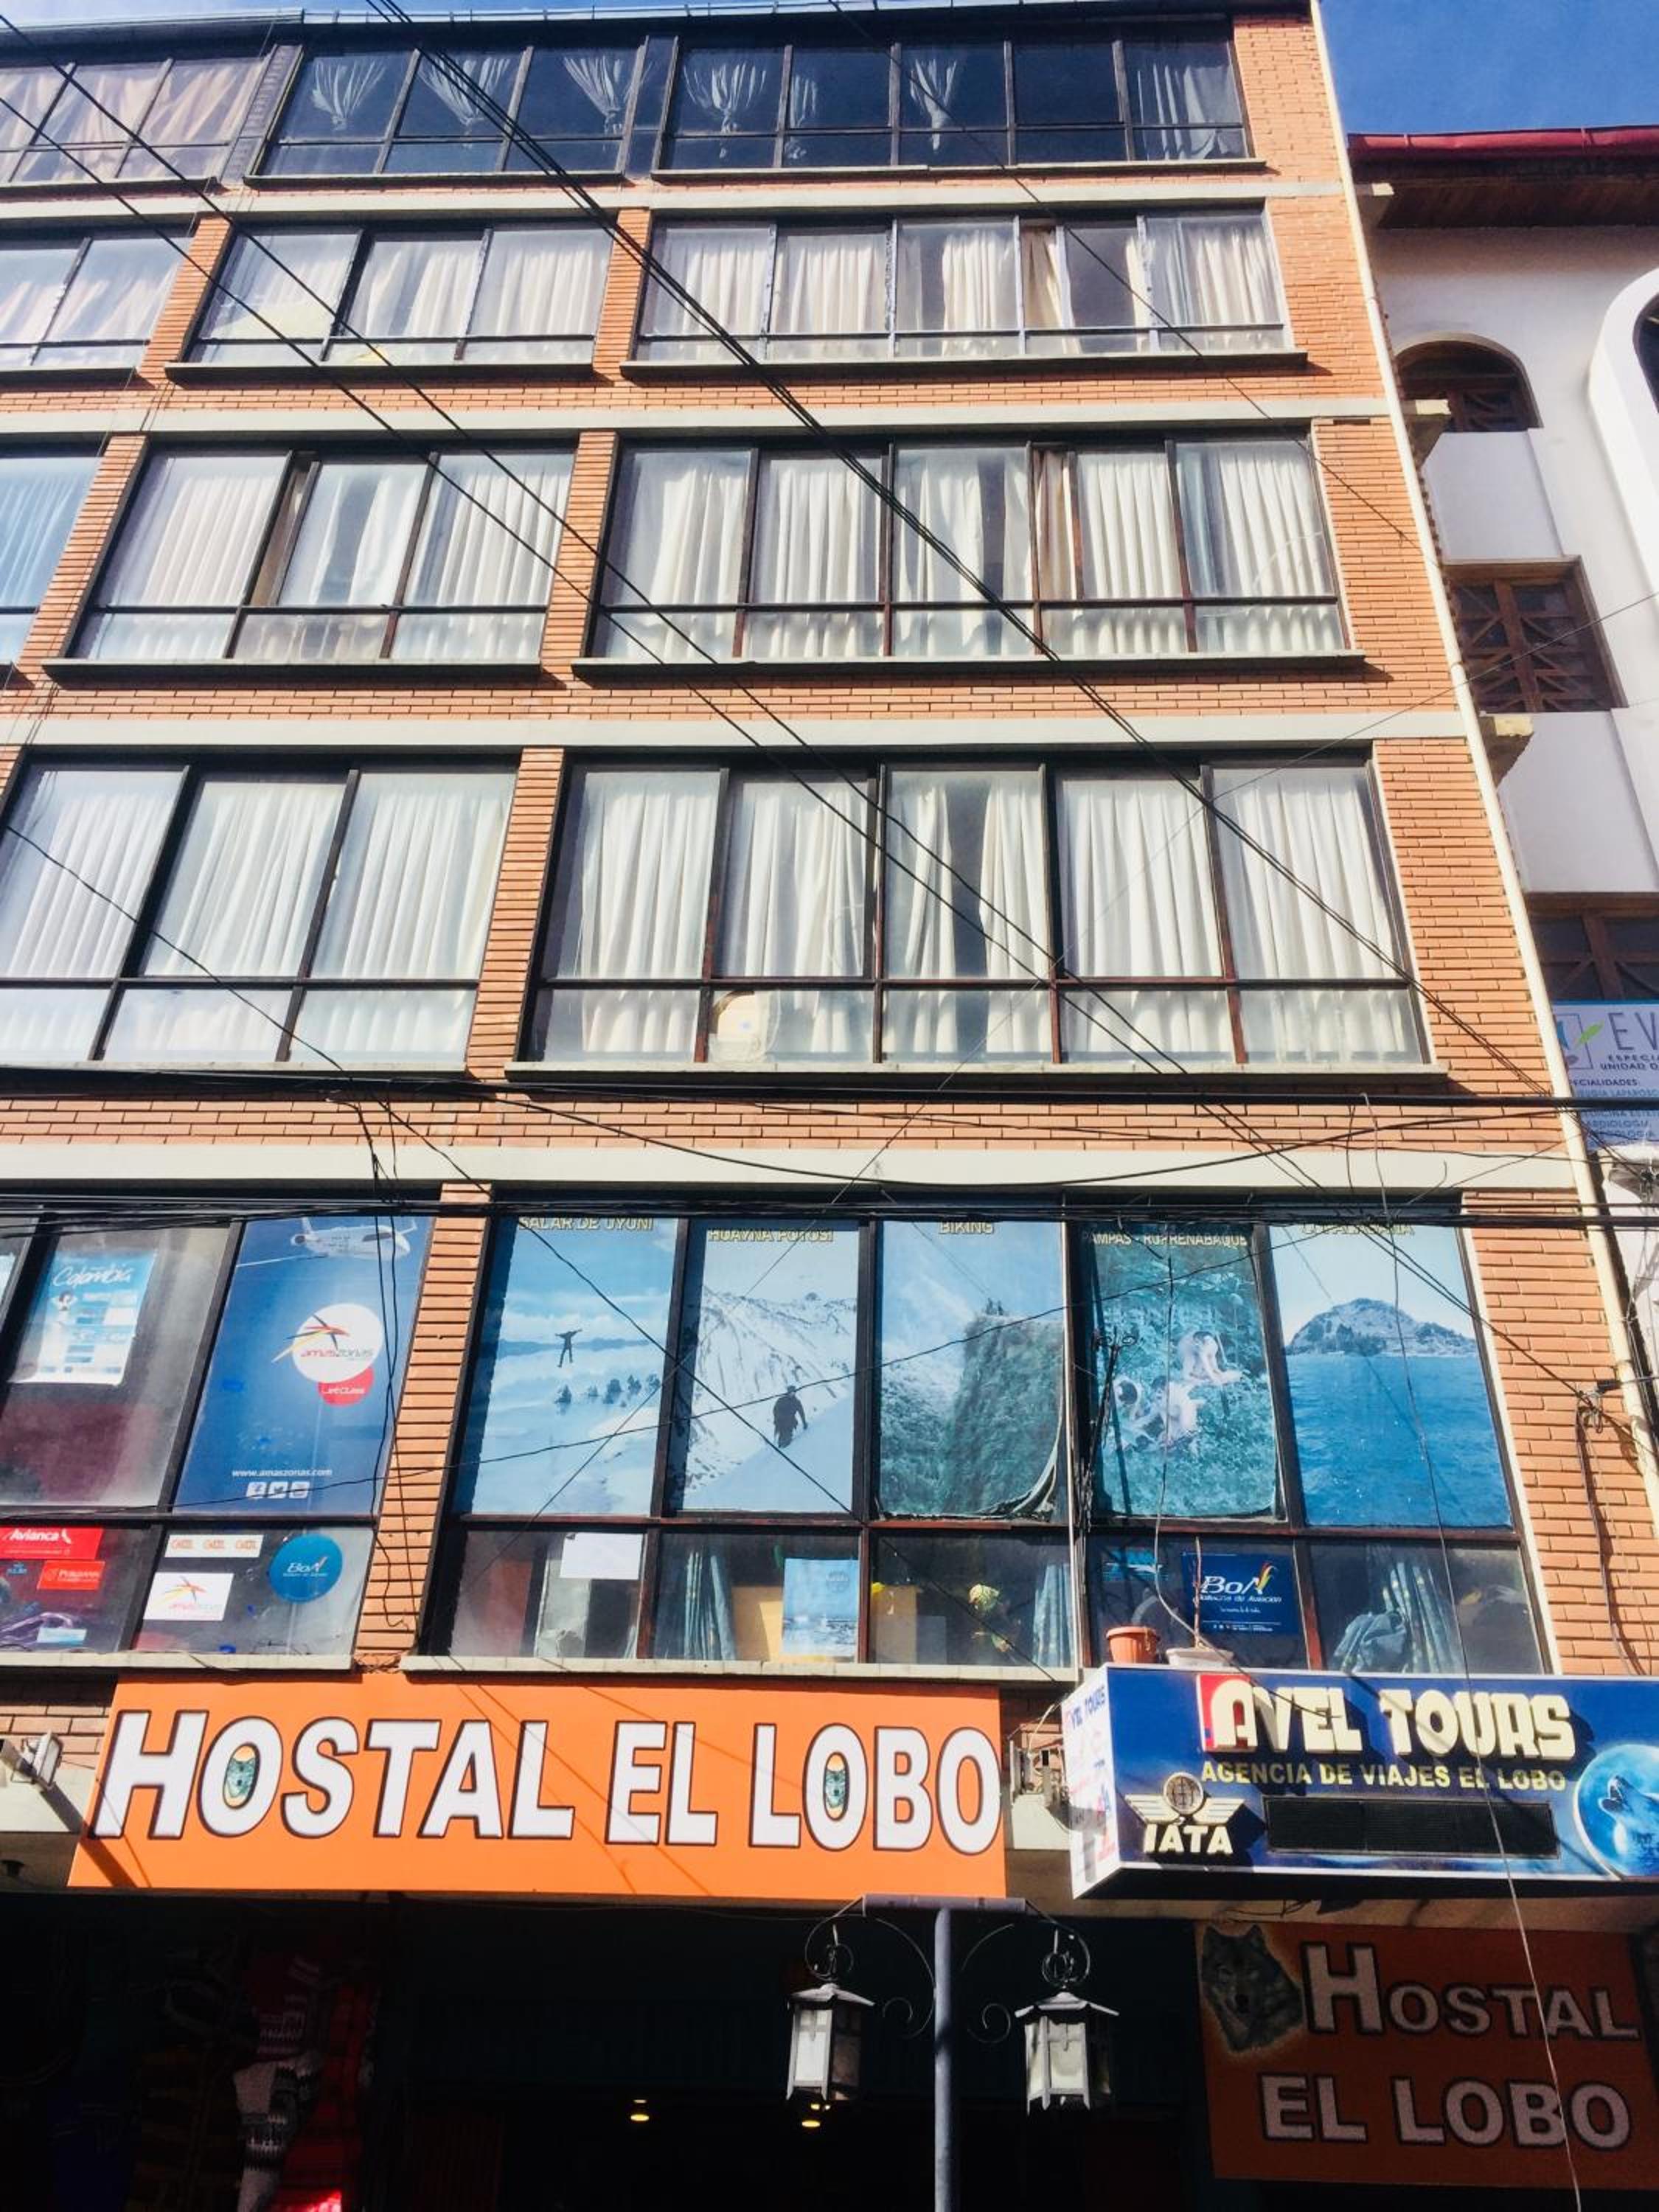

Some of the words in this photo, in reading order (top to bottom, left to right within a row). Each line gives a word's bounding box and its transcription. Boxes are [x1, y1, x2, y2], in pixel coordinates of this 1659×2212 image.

[1600, 1062, 1646, 1071] UNIDAD
[519, 1217, 572, 1230] SALAR
[577, 1217, 599, 1230] DE
[607, 1217, 653, 1231] UYUNI
[1380, 1688, 1576, 1761] TOURS
[92, 1708, 575, 1841] HOSTAL
[606, 1720, 719, 1847] EL
[748, 1722, 1002, 1855] LOBO
[1202, 1760, 1312, 1785] AGENCIA
[1320, 1763, 1353, 1786] DE
[1360, 1764, 1450, 1789] VIAJES
[1459, 1767, 1489, 1790] EL
[1497, 1770, 1567, 1792] LOBO
[1144, 1823, 1234, 1856] IATA
[1301, 1941, 1641, 2041] HOSTAL
[1260, 2073, 1368, 2143] EL
[1394, 2077, 1633, 2151] LOBO
